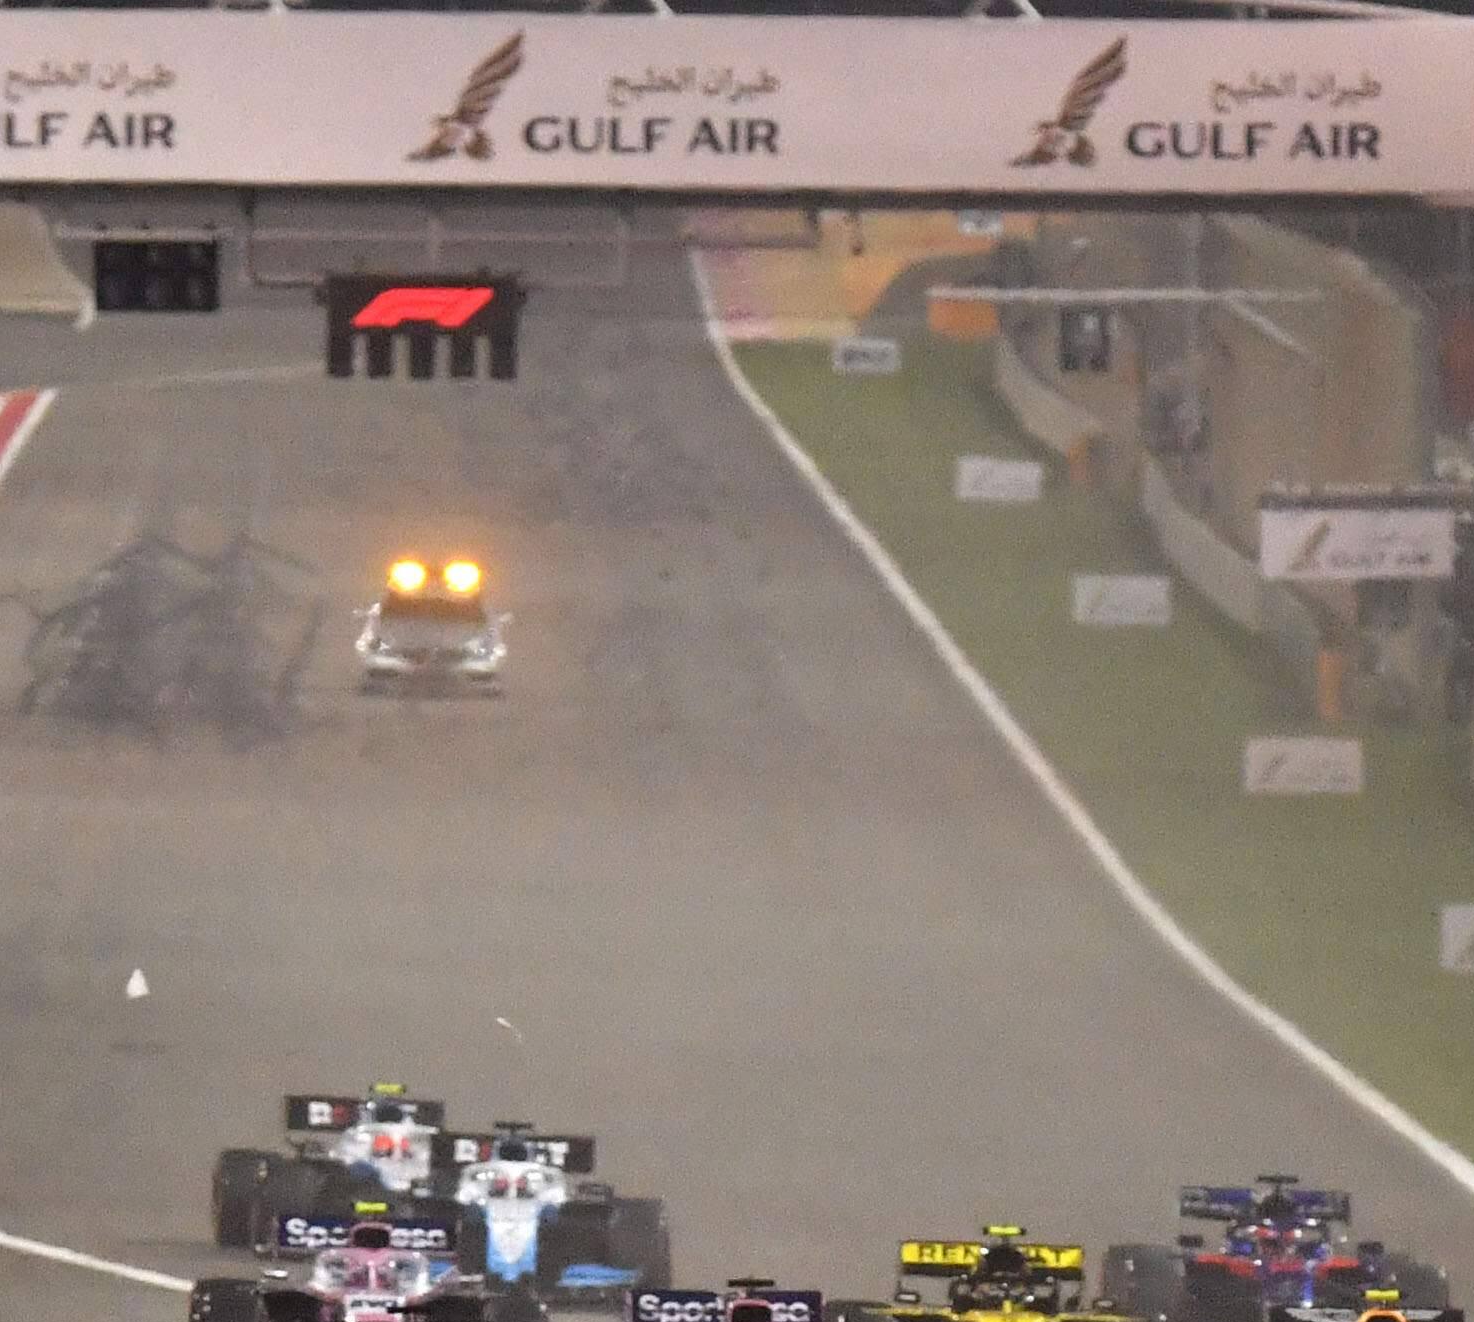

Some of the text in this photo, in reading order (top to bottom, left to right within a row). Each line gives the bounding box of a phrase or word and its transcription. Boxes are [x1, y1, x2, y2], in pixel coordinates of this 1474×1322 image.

[82, 112, 176, 149] AIR
[522, 116, 780, 155] GULF AIR
[1125, 121, 1381, 161] GULF AIR
